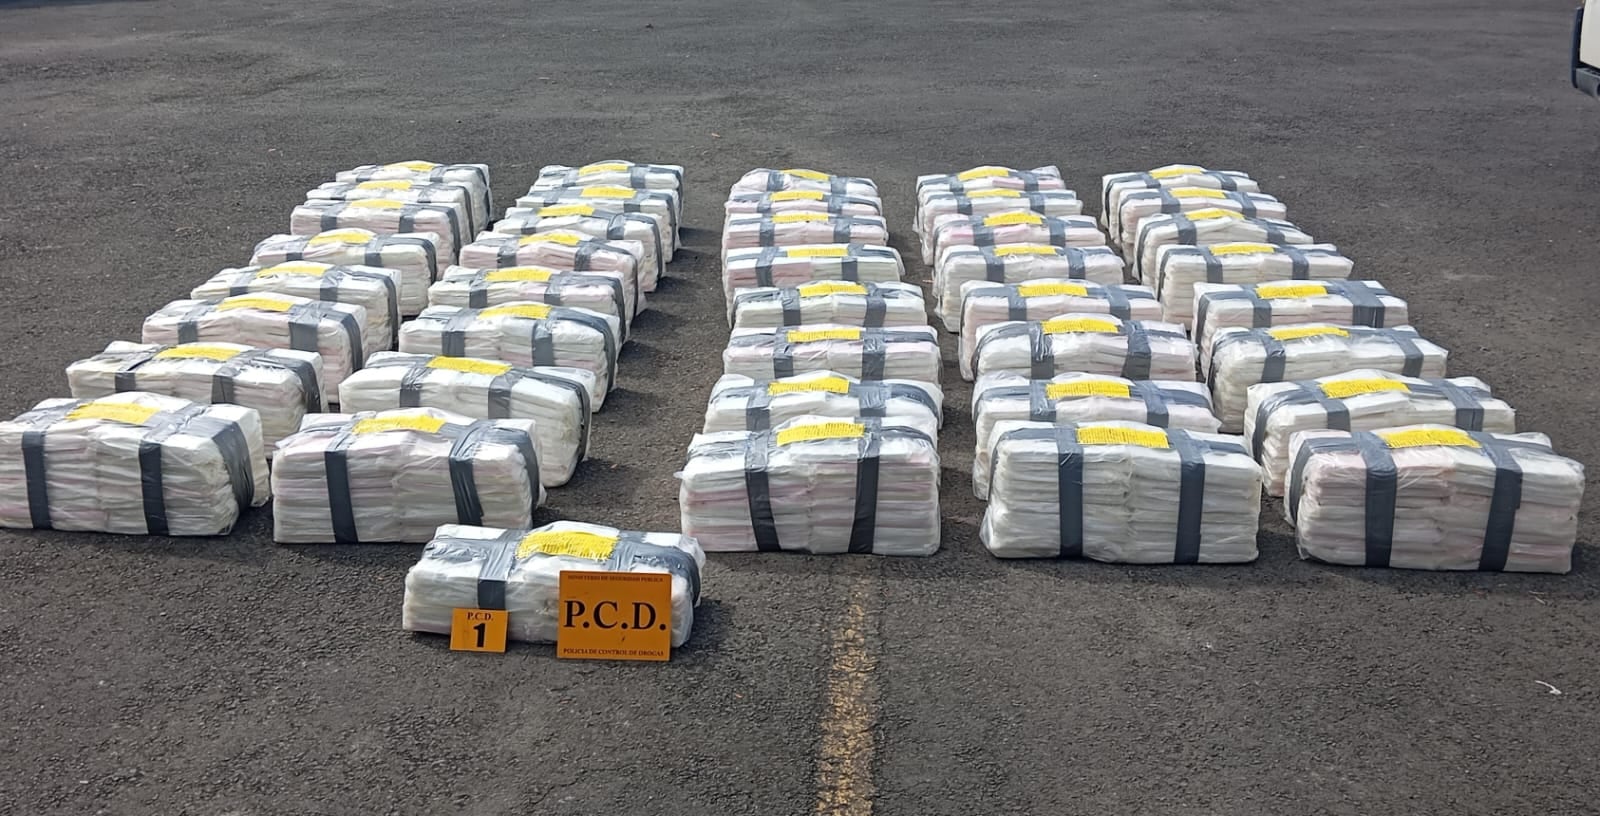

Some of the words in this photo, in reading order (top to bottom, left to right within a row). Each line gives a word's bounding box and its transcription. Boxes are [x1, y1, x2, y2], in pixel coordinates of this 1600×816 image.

[467, 612, 494, 621] P.C.D.
[563, 600, 666, 631] P.C.D.
[473, 623, 485, 648] 1
